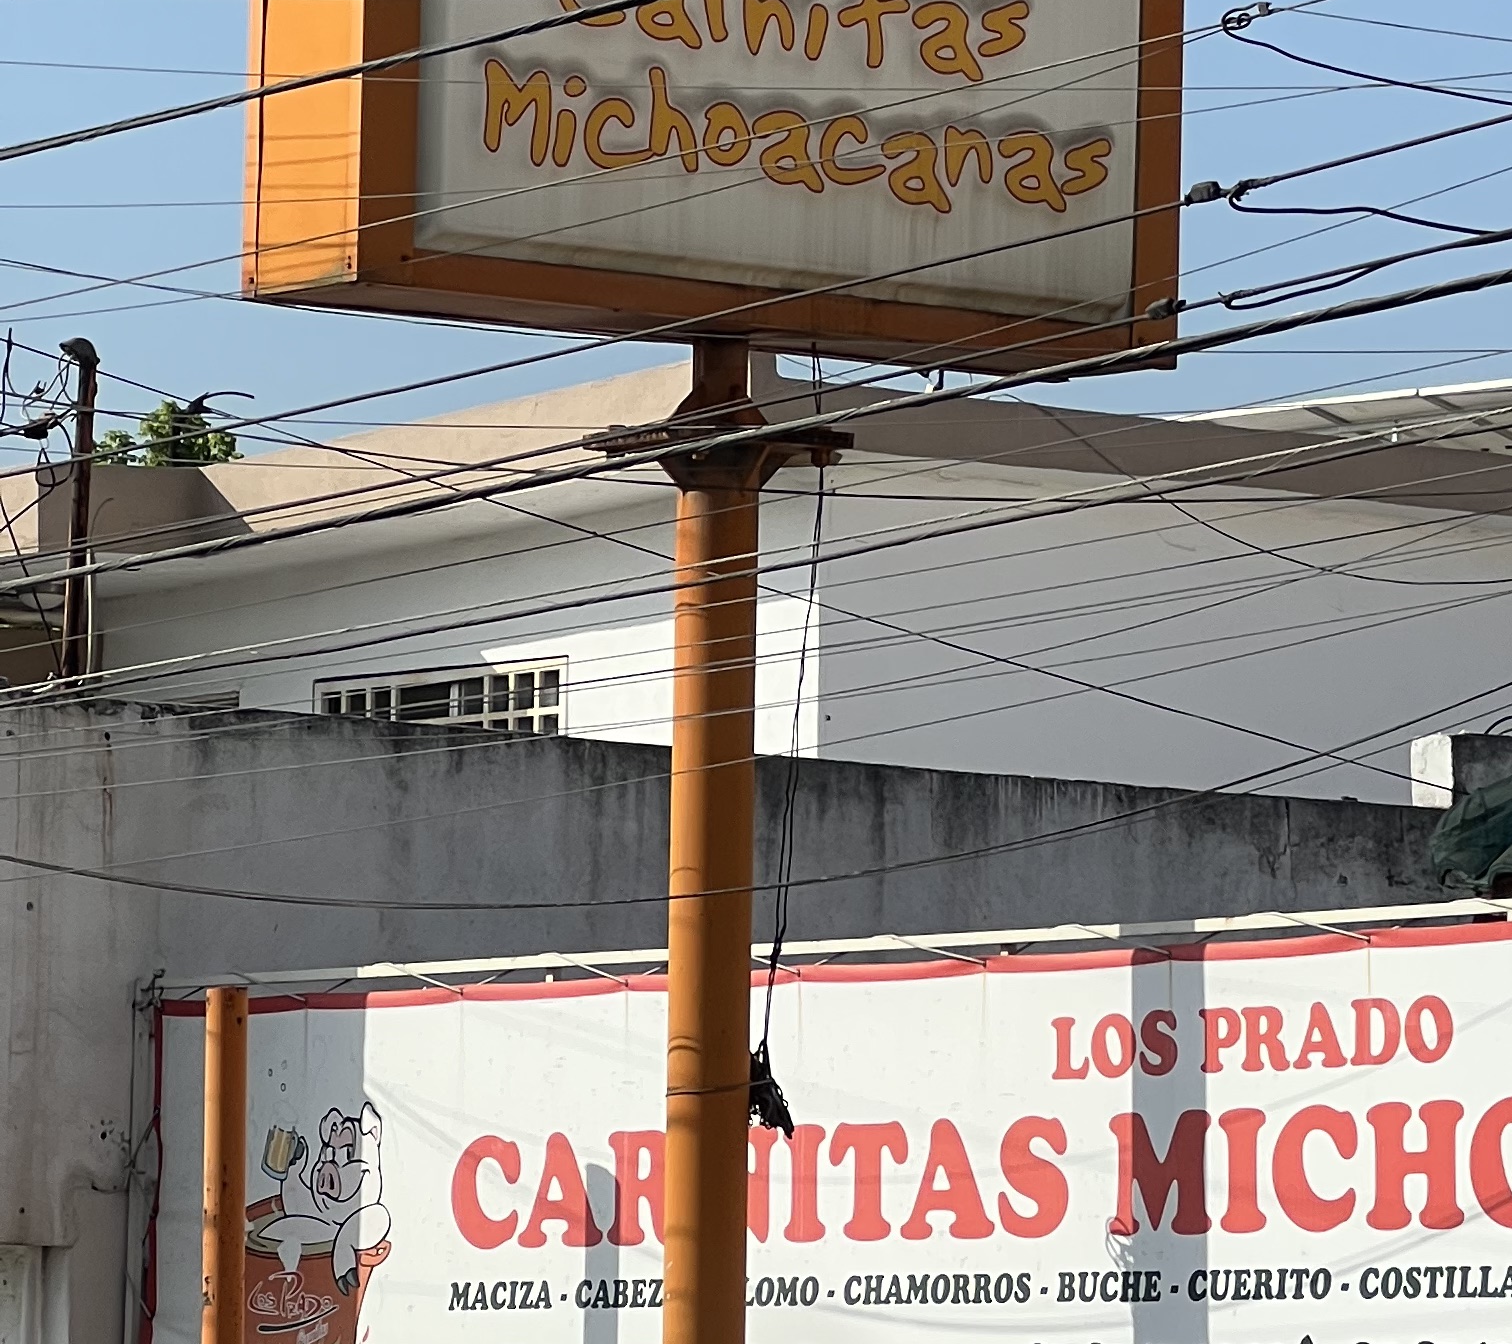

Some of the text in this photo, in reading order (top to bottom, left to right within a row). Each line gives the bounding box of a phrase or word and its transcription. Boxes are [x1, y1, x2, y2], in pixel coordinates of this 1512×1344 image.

[482, 60, 1112, 213] Michoacanas
[1052, 995, 1454, 1080] LOS PRADO
[448, 1280, 552, 1311] MACIZA
[575, 1278, 664, 1309] CABEZ
[844, 1272, 1031, 1306] CHAMORROS
[1056, 1270, 1162, 1303] BUCHE
[1187, 1267, 1332, 1302] CUERITO
